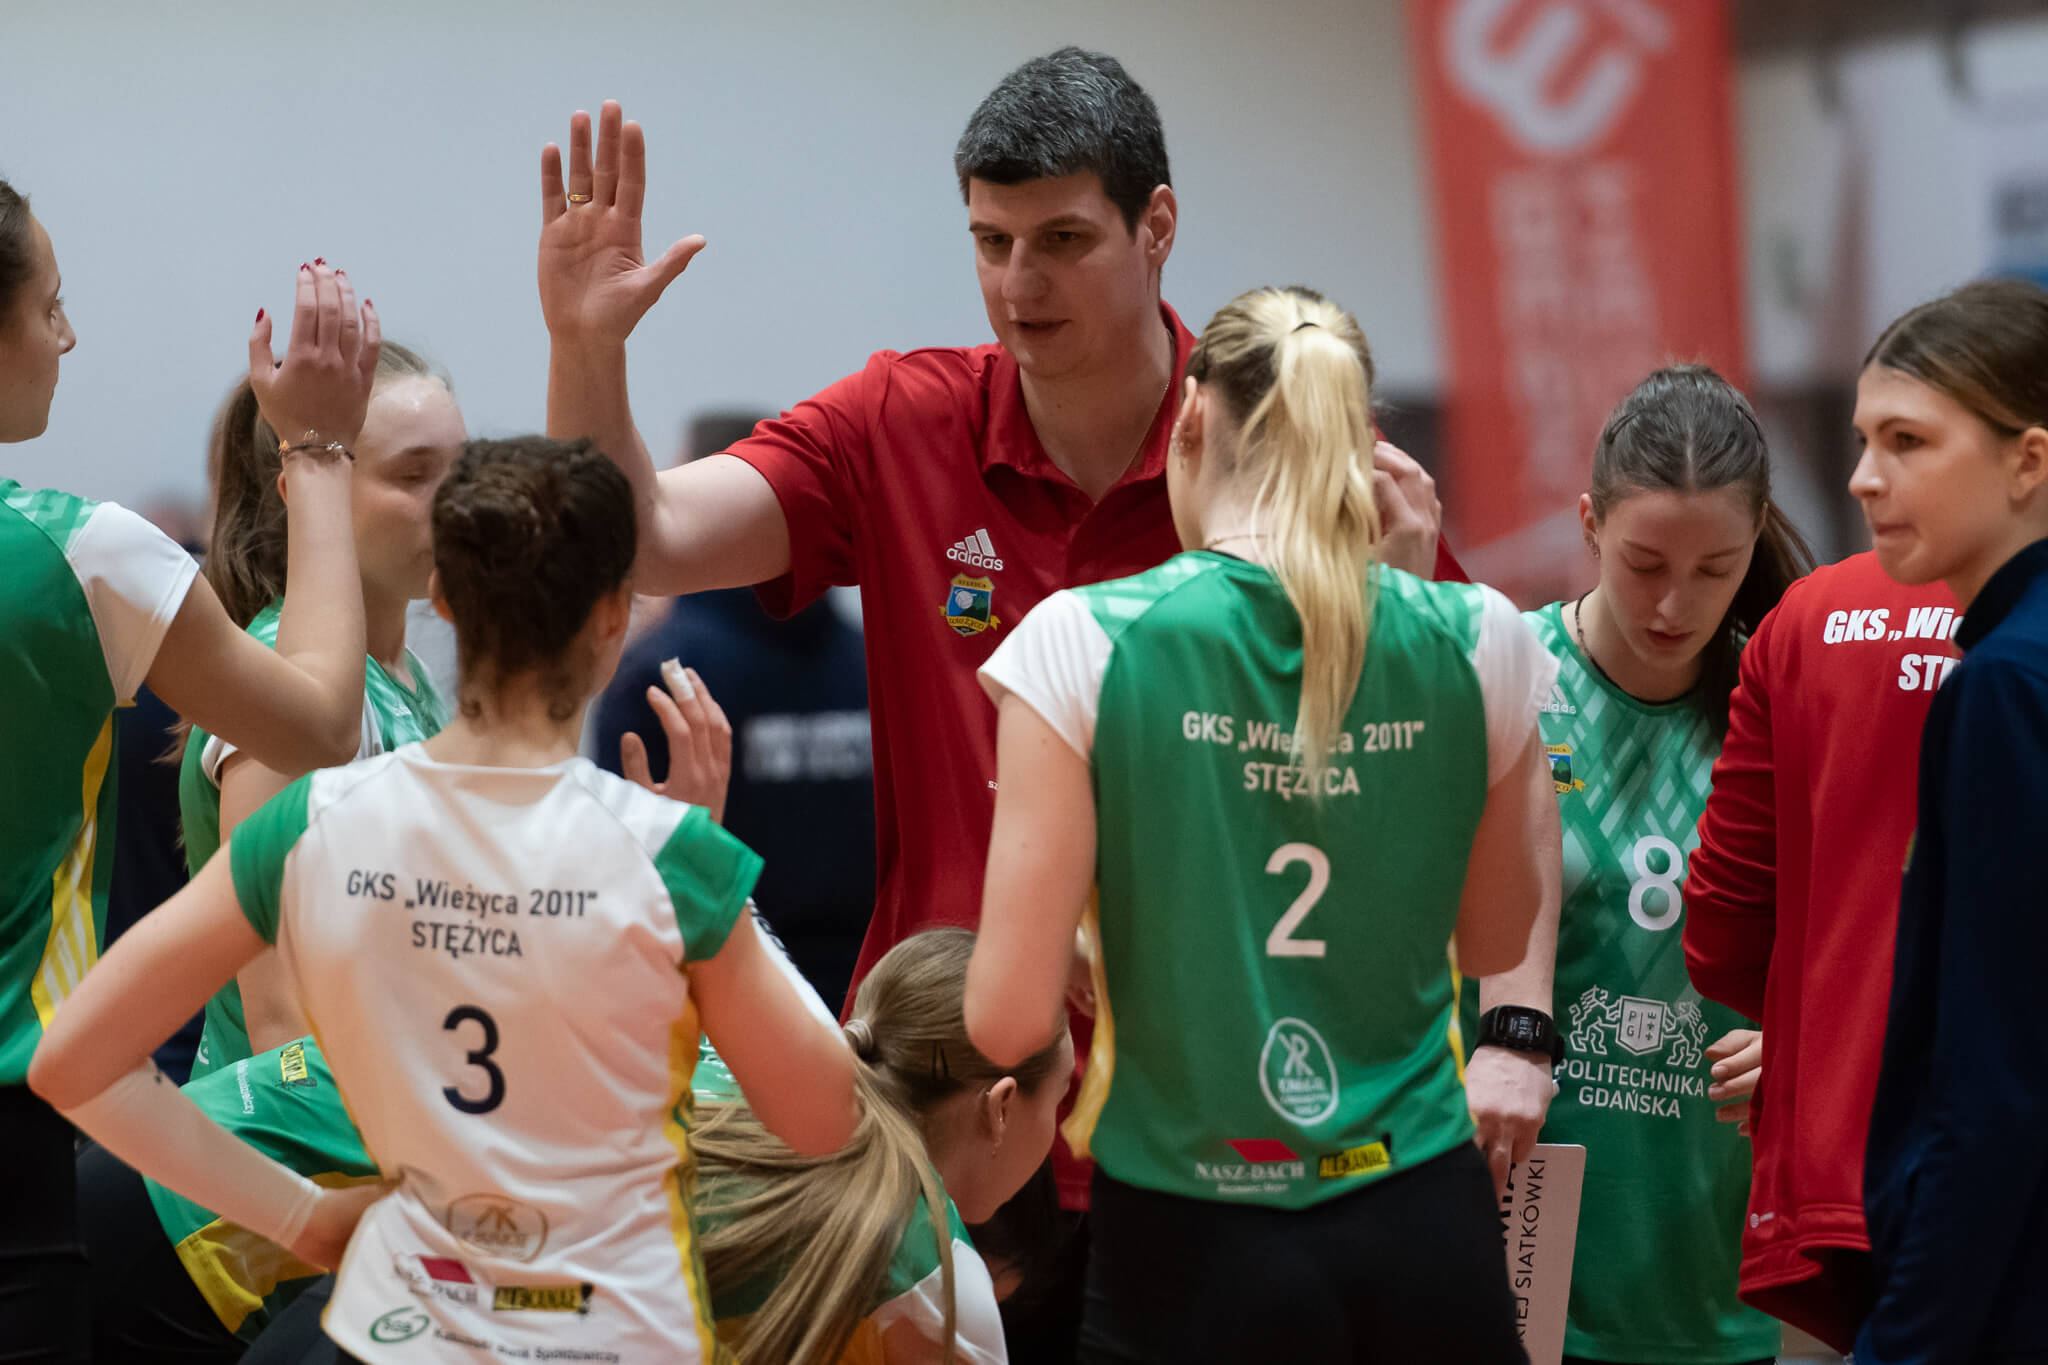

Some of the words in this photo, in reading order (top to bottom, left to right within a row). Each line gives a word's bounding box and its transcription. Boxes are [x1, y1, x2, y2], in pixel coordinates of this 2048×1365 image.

[946, 547, 1004, 571] adidas
[1183, 711, 1233, 744] GKS
[346, 869, 396, 900] GKS
[1264, 842, 1331, 958] 2
[1627, 835, 1683, 932] 8
[411, 920, 523, 958] STĘŻYCA
[442, 1004, 506, 1115] 3
[1554, 1059, 1705, 1097] POLITECHNIKA
[1578, 1085, 1681, 1119] GDAŃSKA
[1515, 1159, 1546, 1289] SIATKÓWKI
